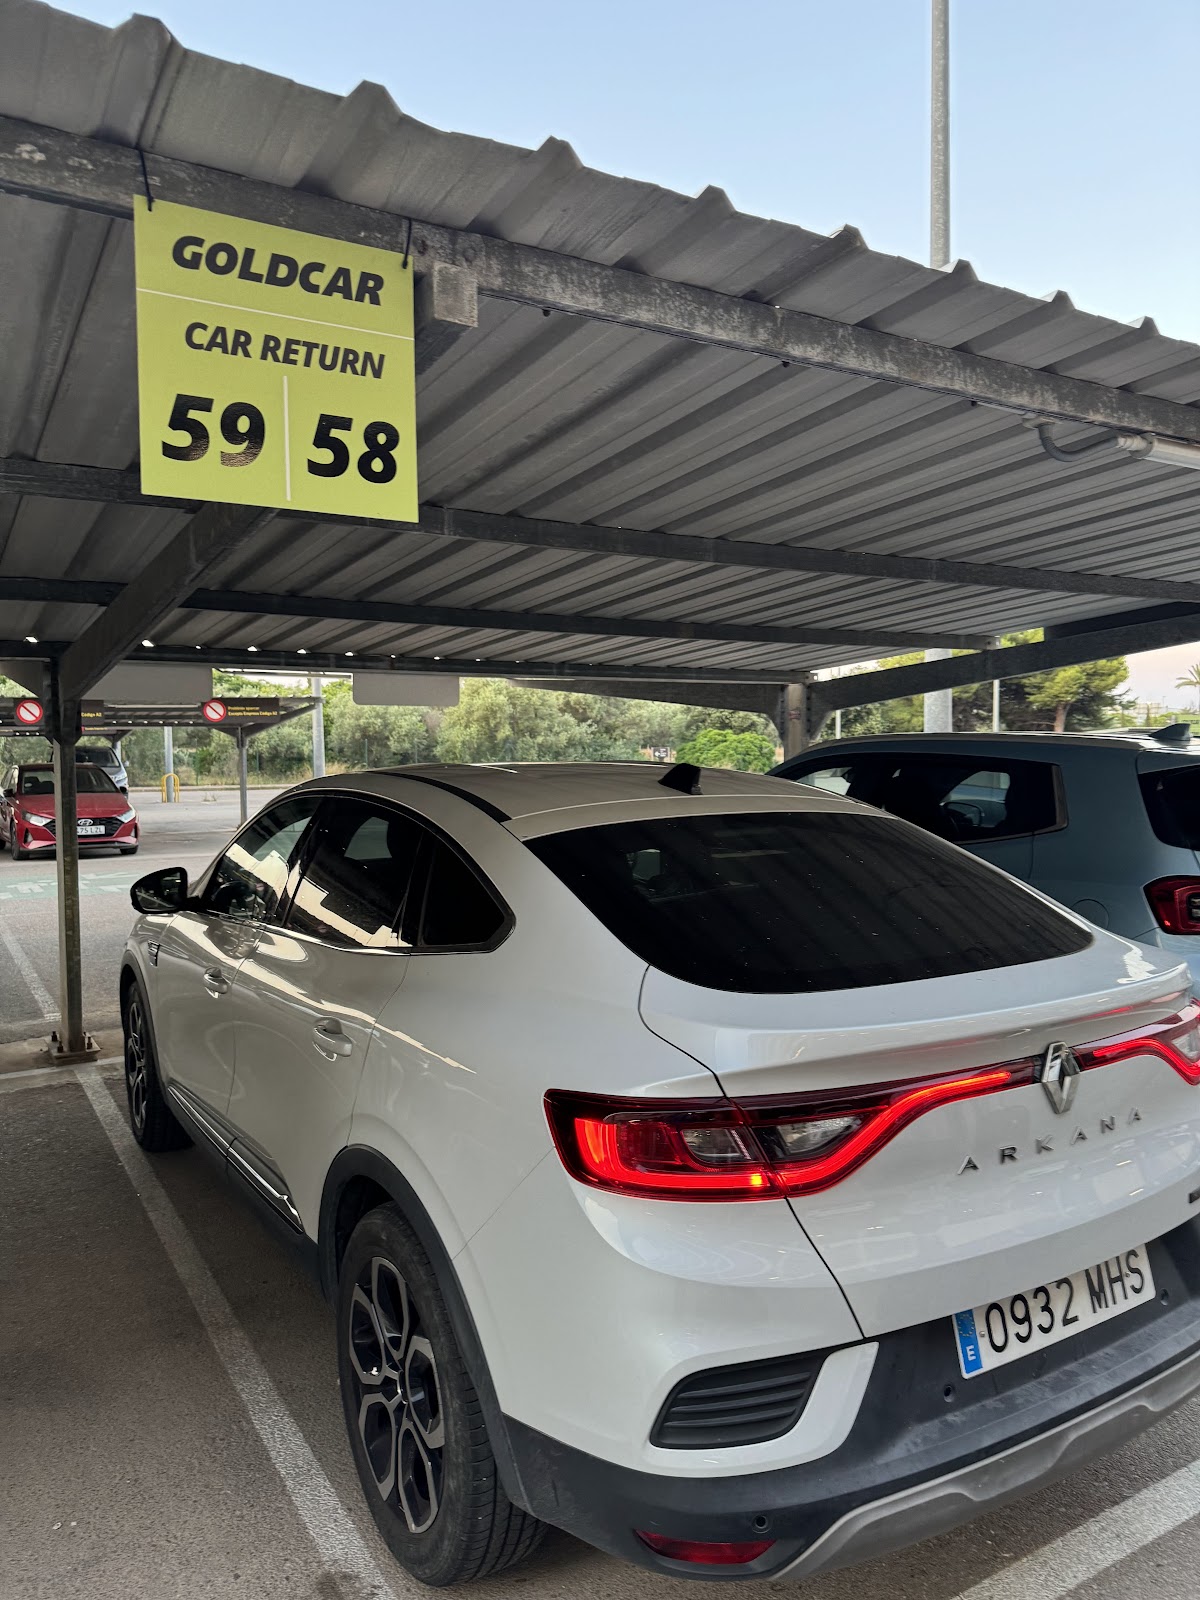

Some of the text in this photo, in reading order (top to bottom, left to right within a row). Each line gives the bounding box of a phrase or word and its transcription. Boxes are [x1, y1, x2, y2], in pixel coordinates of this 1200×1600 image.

[172, 235, 385, 306] GOLDCAR
[185, 322, 386, 379] CAR RETURN
[161, 393, 266, 468] 59
[307, 413, 400, 484] 58
[957, 1107, 1143, 1176] ARKANA
[985, 1249, 1145, 1354] 0932 MHS
[965, 1344, 977, 1362] E
